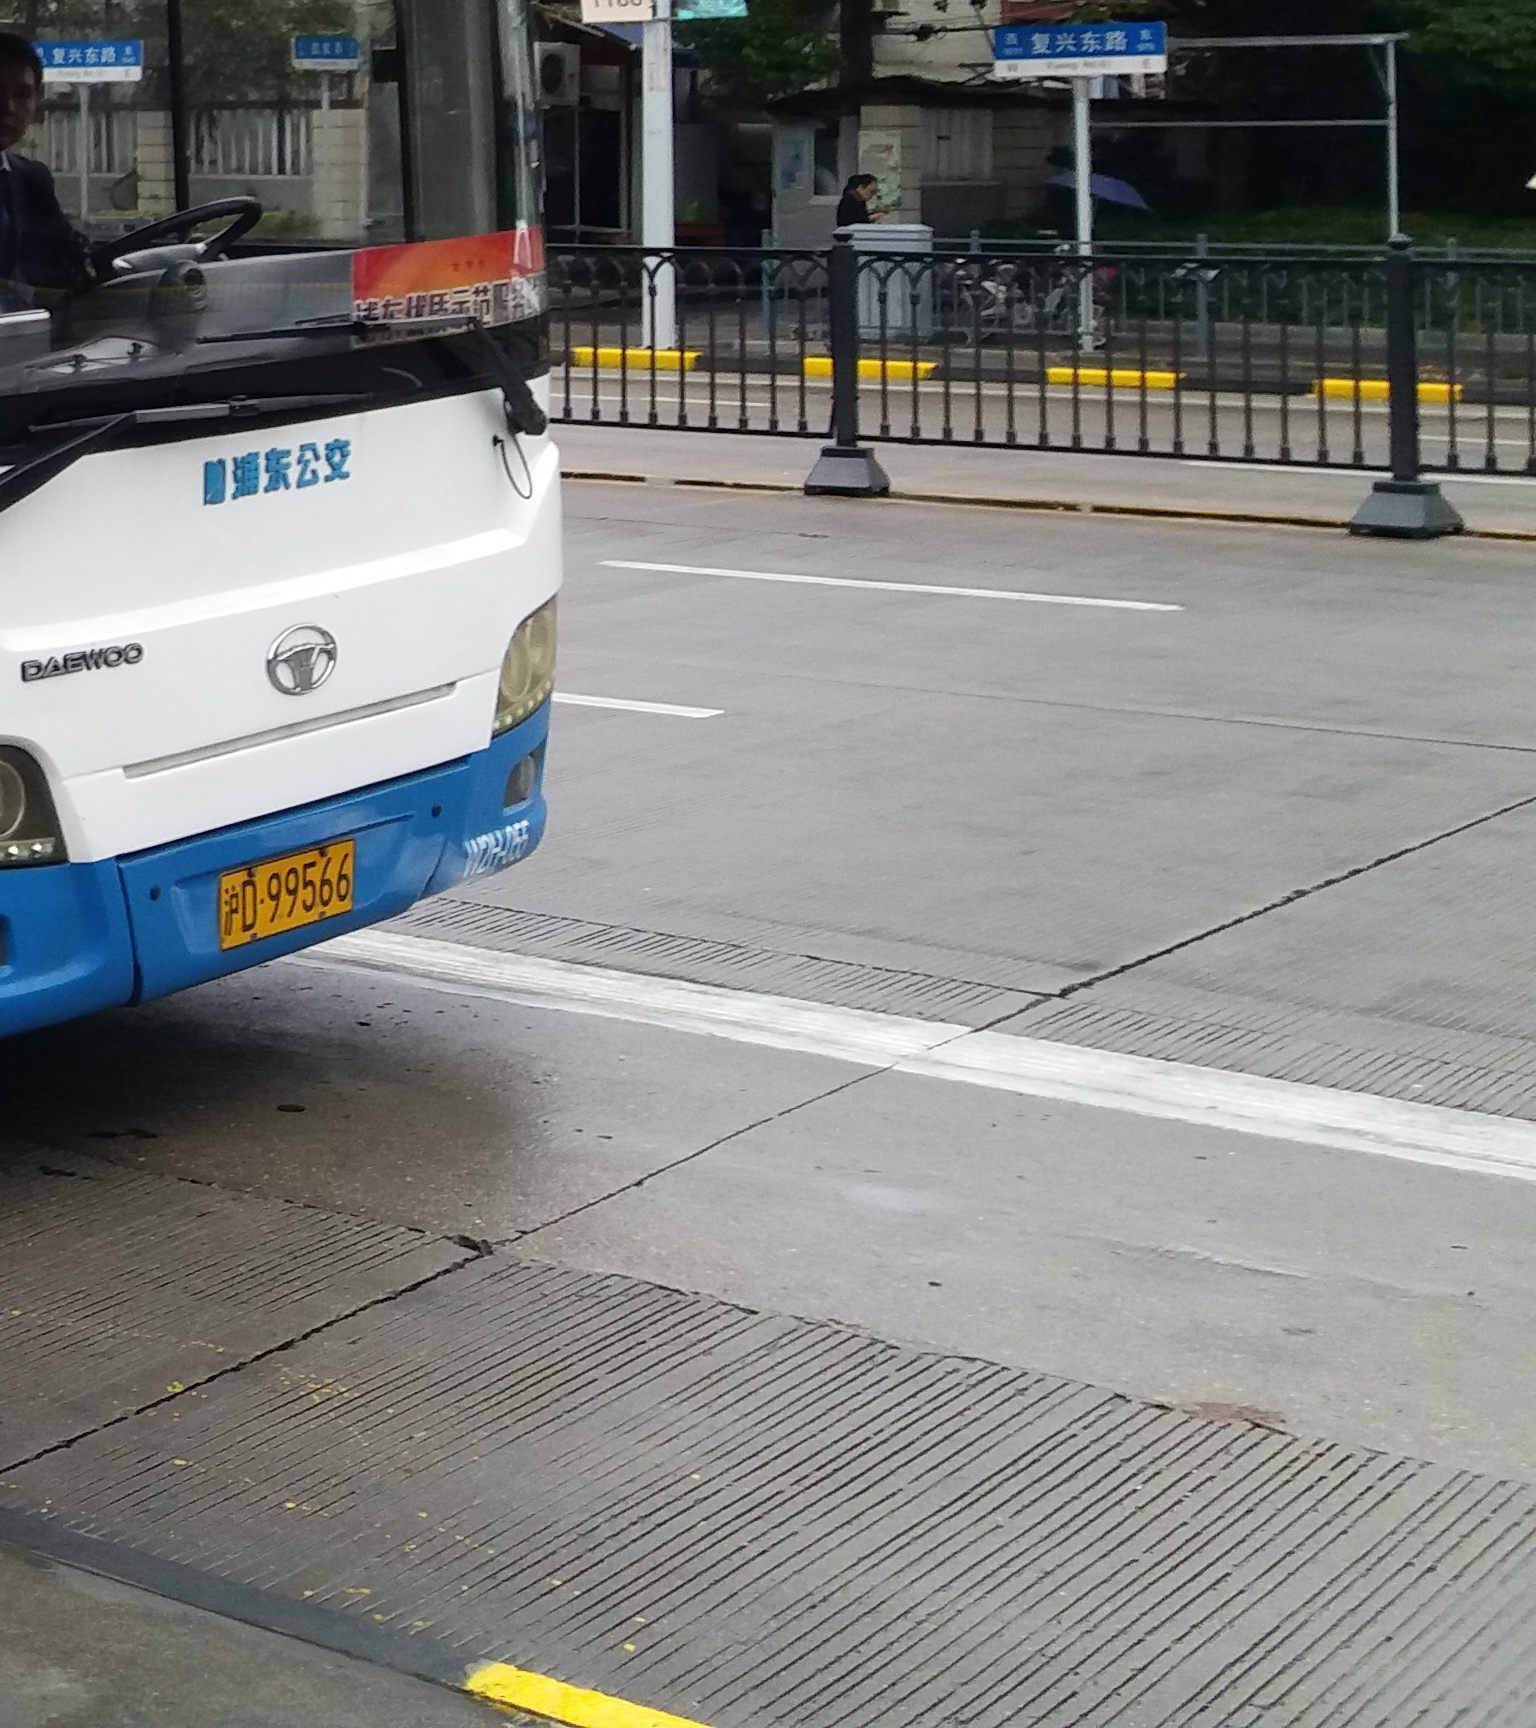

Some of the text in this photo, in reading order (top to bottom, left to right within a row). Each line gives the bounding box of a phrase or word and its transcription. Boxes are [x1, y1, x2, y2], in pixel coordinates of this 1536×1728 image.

[51, 45, 117, 65] 复兴东路
[1030, 30, 1128, 55] 复兴东路
[231, 438, 352, 501] 浦东公交
[21, 642, 145, 683] DAEWOO
